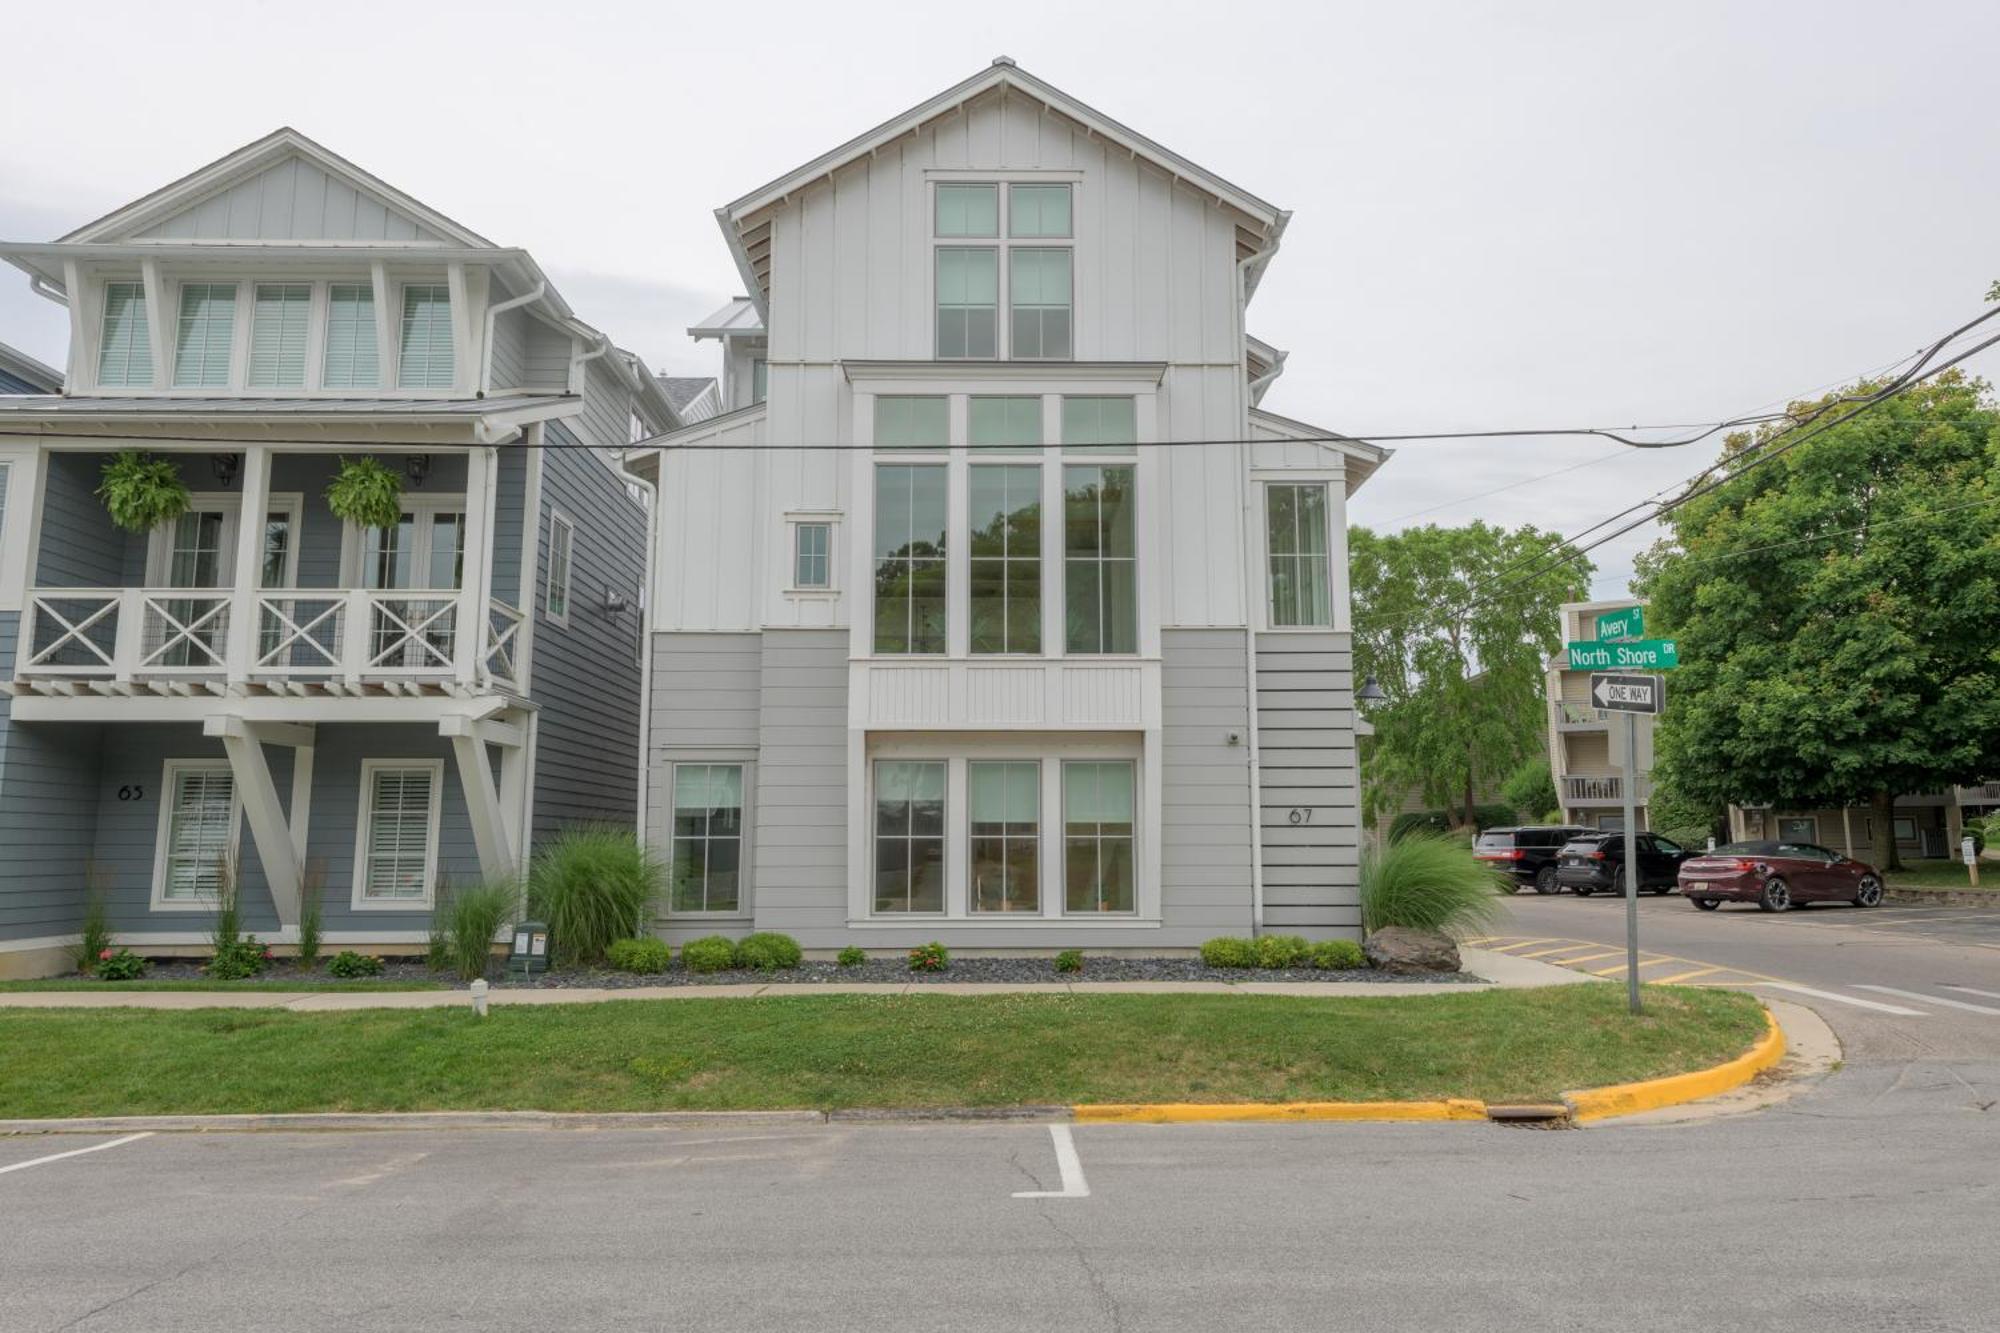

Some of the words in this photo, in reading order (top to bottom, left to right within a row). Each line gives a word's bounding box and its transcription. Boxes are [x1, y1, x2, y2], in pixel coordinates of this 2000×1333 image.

[1600, 618, 1629, 638] Avery
[1570, 648, 1611, 666] North
[1617, 647, 1657, 664] Shore
[1663, 643, 1676, 654] DR
[1608, 686, 1627, 700] ONE
[1629, 686, 1649, 702] WAY
[118, 784, 143, 801] 65
[1289, 808, 1312, 824] 67
